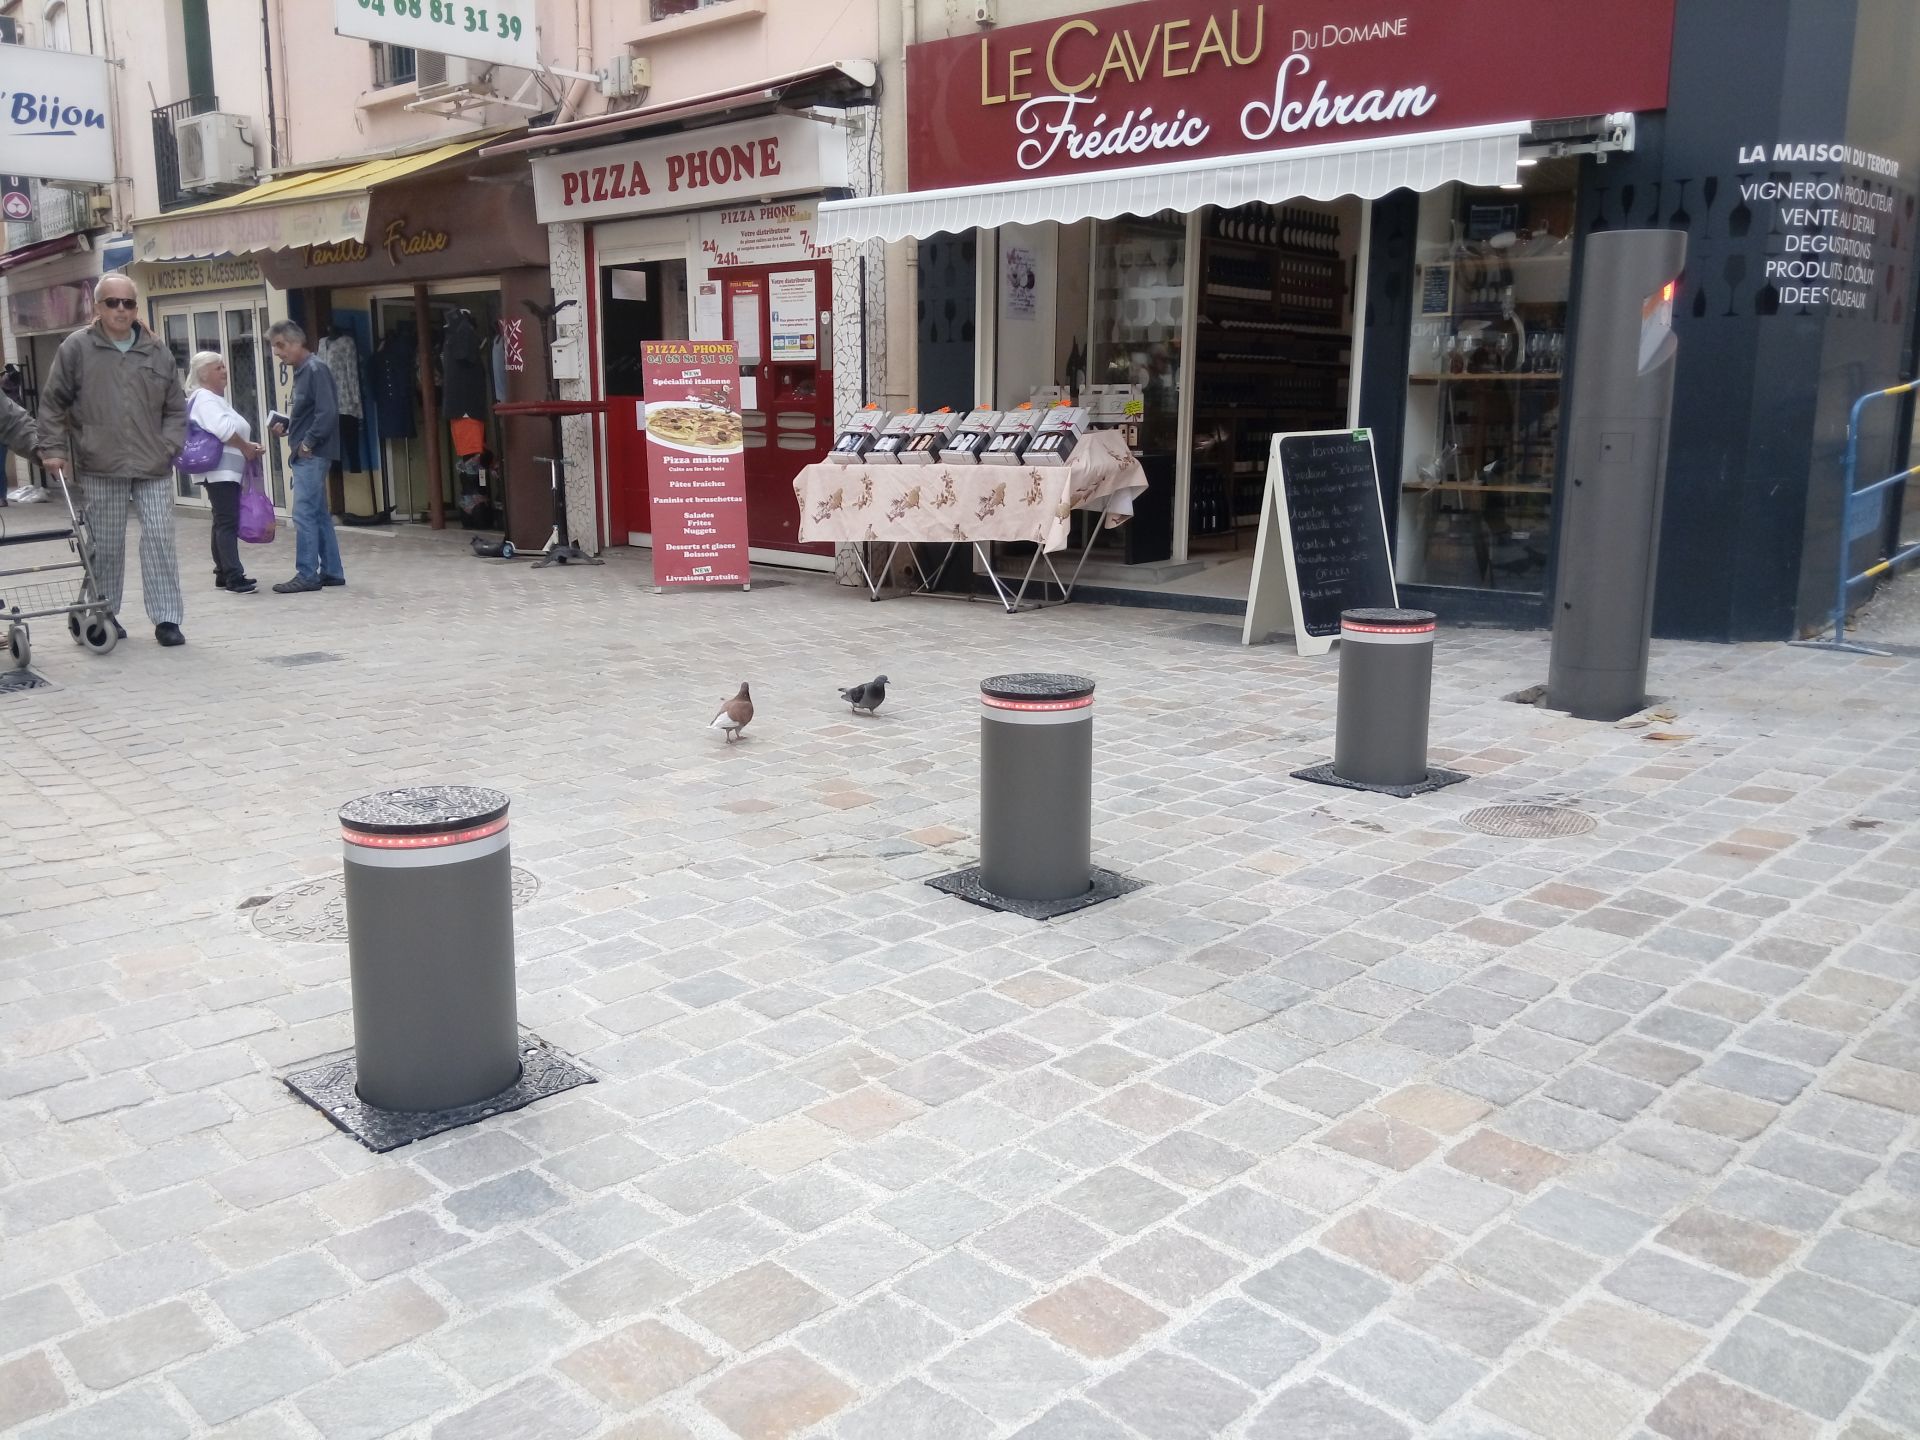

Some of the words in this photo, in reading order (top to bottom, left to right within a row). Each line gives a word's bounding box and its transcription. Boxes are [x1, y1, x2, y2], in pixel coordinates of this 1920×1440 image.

[394, 0, 422, 19] 68
[430, 0, 456, 25] 81
[464, 6, 489, 33] 31
[497, 13, 522, 42] 39
[1016, 94, 1210, 170] Frédéric
[1240, 53, 1437, 140] Schram
[561, 161, 651, 206] PIZZA
[666, 137, 781, 191] PHONE
[1738, 145, 1766, 164] LA
[1772, 143, 1851, 162] MAISON
[1853, 149, 1866, 168] DU
[1867, 153, 1899, 178] TERROIR
[1740, 182, 1843, 201] VIGNERON
[1844, 186, 1893, 214] PRODUCTEUR
[721, 210, 755, 224] PIZZA
[760, 204, 797, 220] PHONE
[1781, 208, 1838, 226] VENTE
[1839, 214, 1850, 229] AU
[1852, 214, 1876, 235] DETAIL
[383, 219, 448, 268] Fraise
[1785, 235, 1871, 260] DEGUSTATIONS
[1765, 261, 1843, 281] PRODUITS
[1843, 263, 1875, 286] LOCAUX
[1778, 287, 1830, 304] IDEES
[1831, 288, 1866, 310] CADEAUX
[646, 344, 687, 354] PIZZA
[693, 344, 734, 354] PHONE
[647, 355, 662, 364] 04
[665, 355, 680, 364] 68
[683, 354, 698, 363] 81
[701, 355, 715, 364] 31
[719, 355, 734, 364] 39
[652, 378, 693, 386] Spécialité
[663, 456, 690, 464] Pizza
[692, 456, 730, 464] maison
[683, 528, 716, 536] Nuggets
[665, 543, 700, 551] Desserts
[711, 543, 736, 551] glaces
[665, 574, 704, 582] Livraison
[705, 574, 739, 582] gratuite
